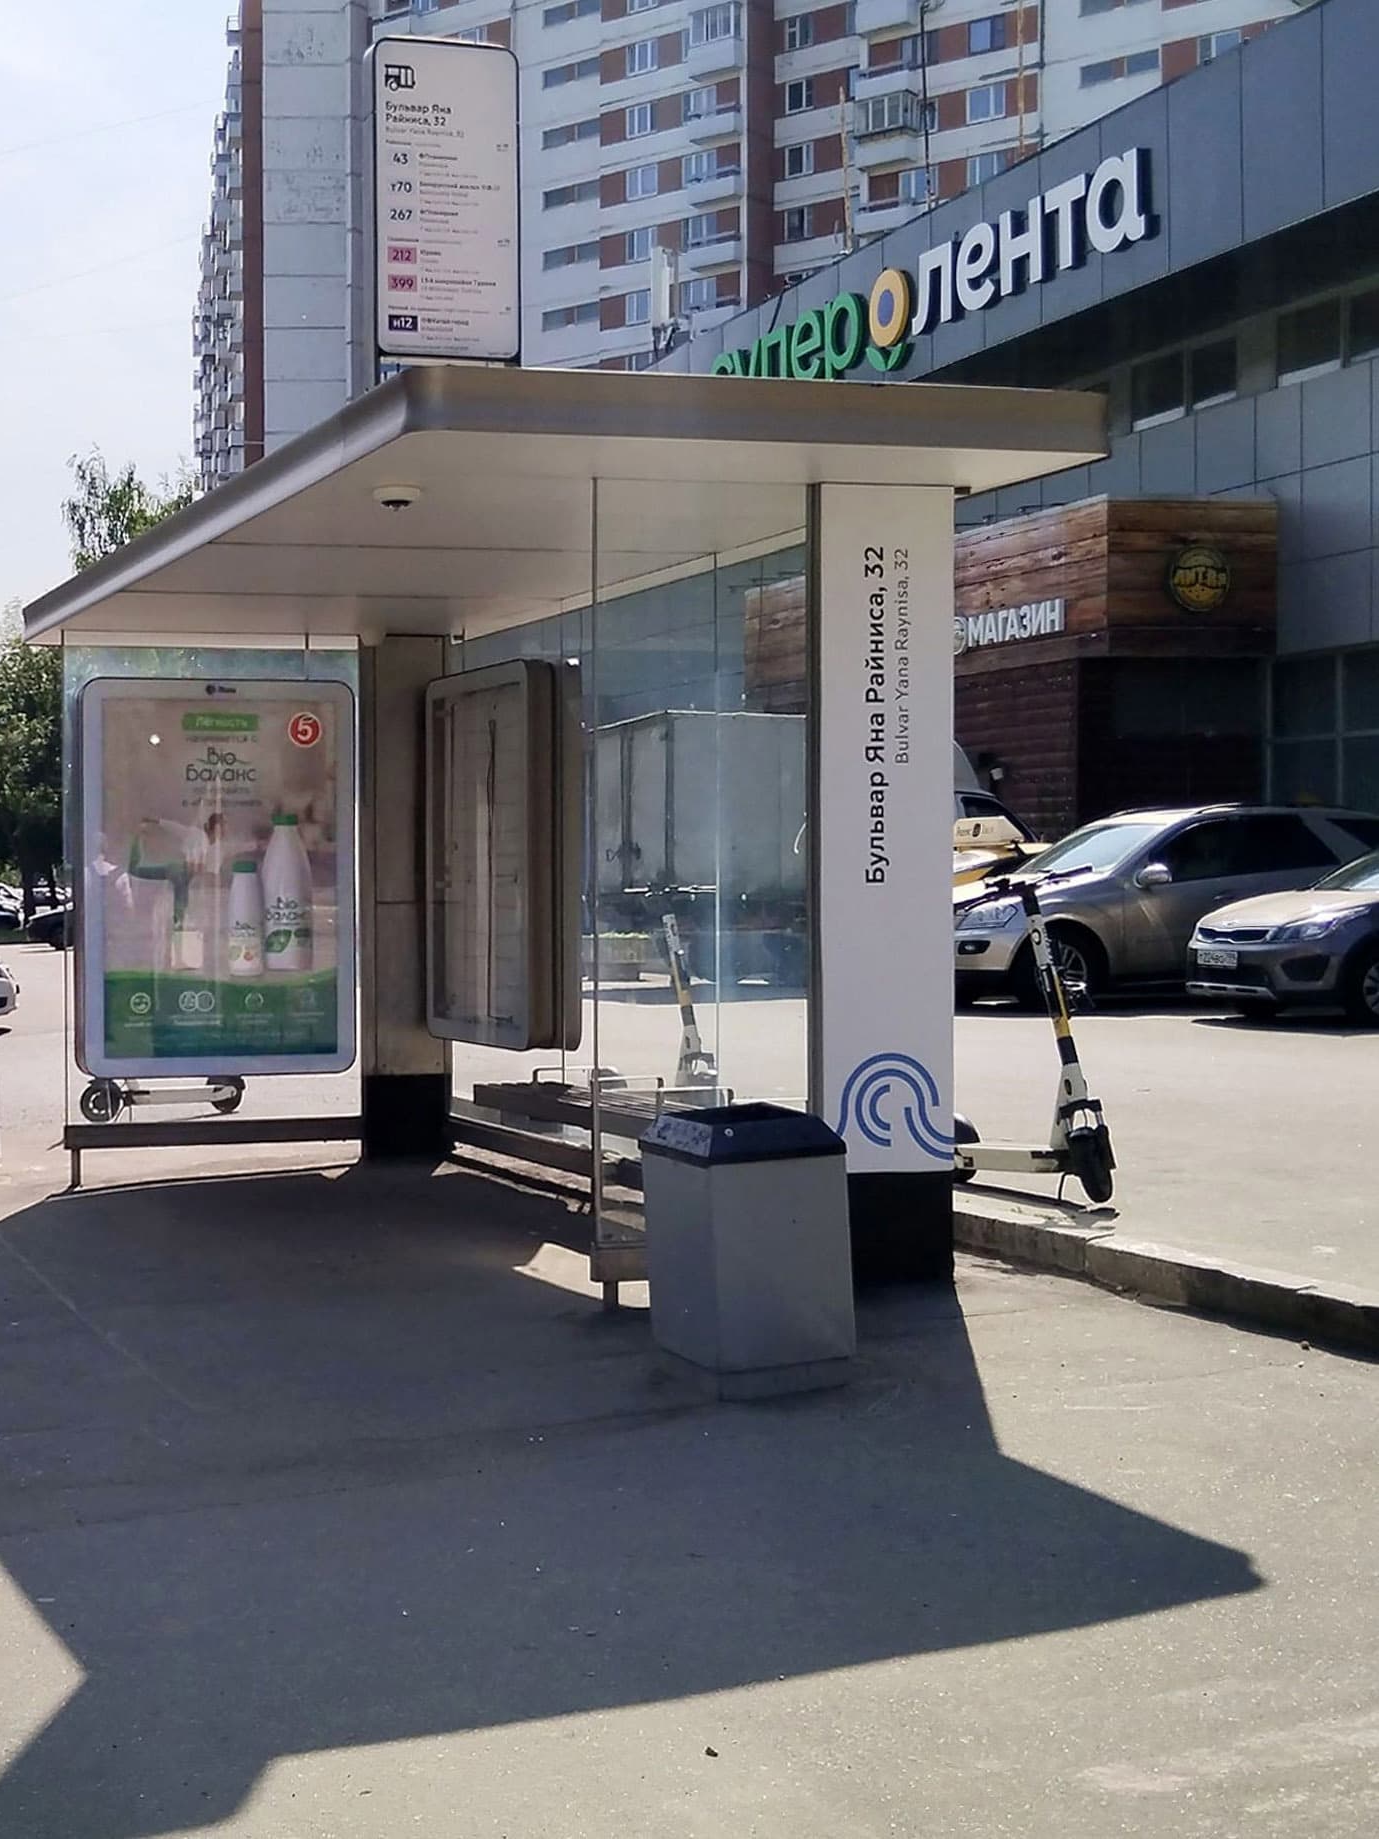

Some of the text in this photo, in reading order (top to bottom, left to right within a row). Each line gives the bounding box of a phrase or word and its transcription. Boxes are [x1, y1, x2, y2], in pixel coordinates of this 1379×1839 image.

[385, 101, 452, 114] Бульвар Яна
[433, 116, 447, 126] 32
[393, 153, 408, 164] 43
[390, 181, 412, 193] т70
[390, 209, 412, 220] 267
[911, 147, 1152, 336] лента
[392, 250, 412, 261] 212
[391, 277, 413, 289] 399
[393, 317, 413, 329] н12
[967, 598, 1064, 648] МАГАЗИН
[894, 549, 912, 764] Bulvar Yana Raynisa, 32
[864, 547, 890, 883] Бульвар Яна Райниса, 32
[296, 717, 314, 741] 5
